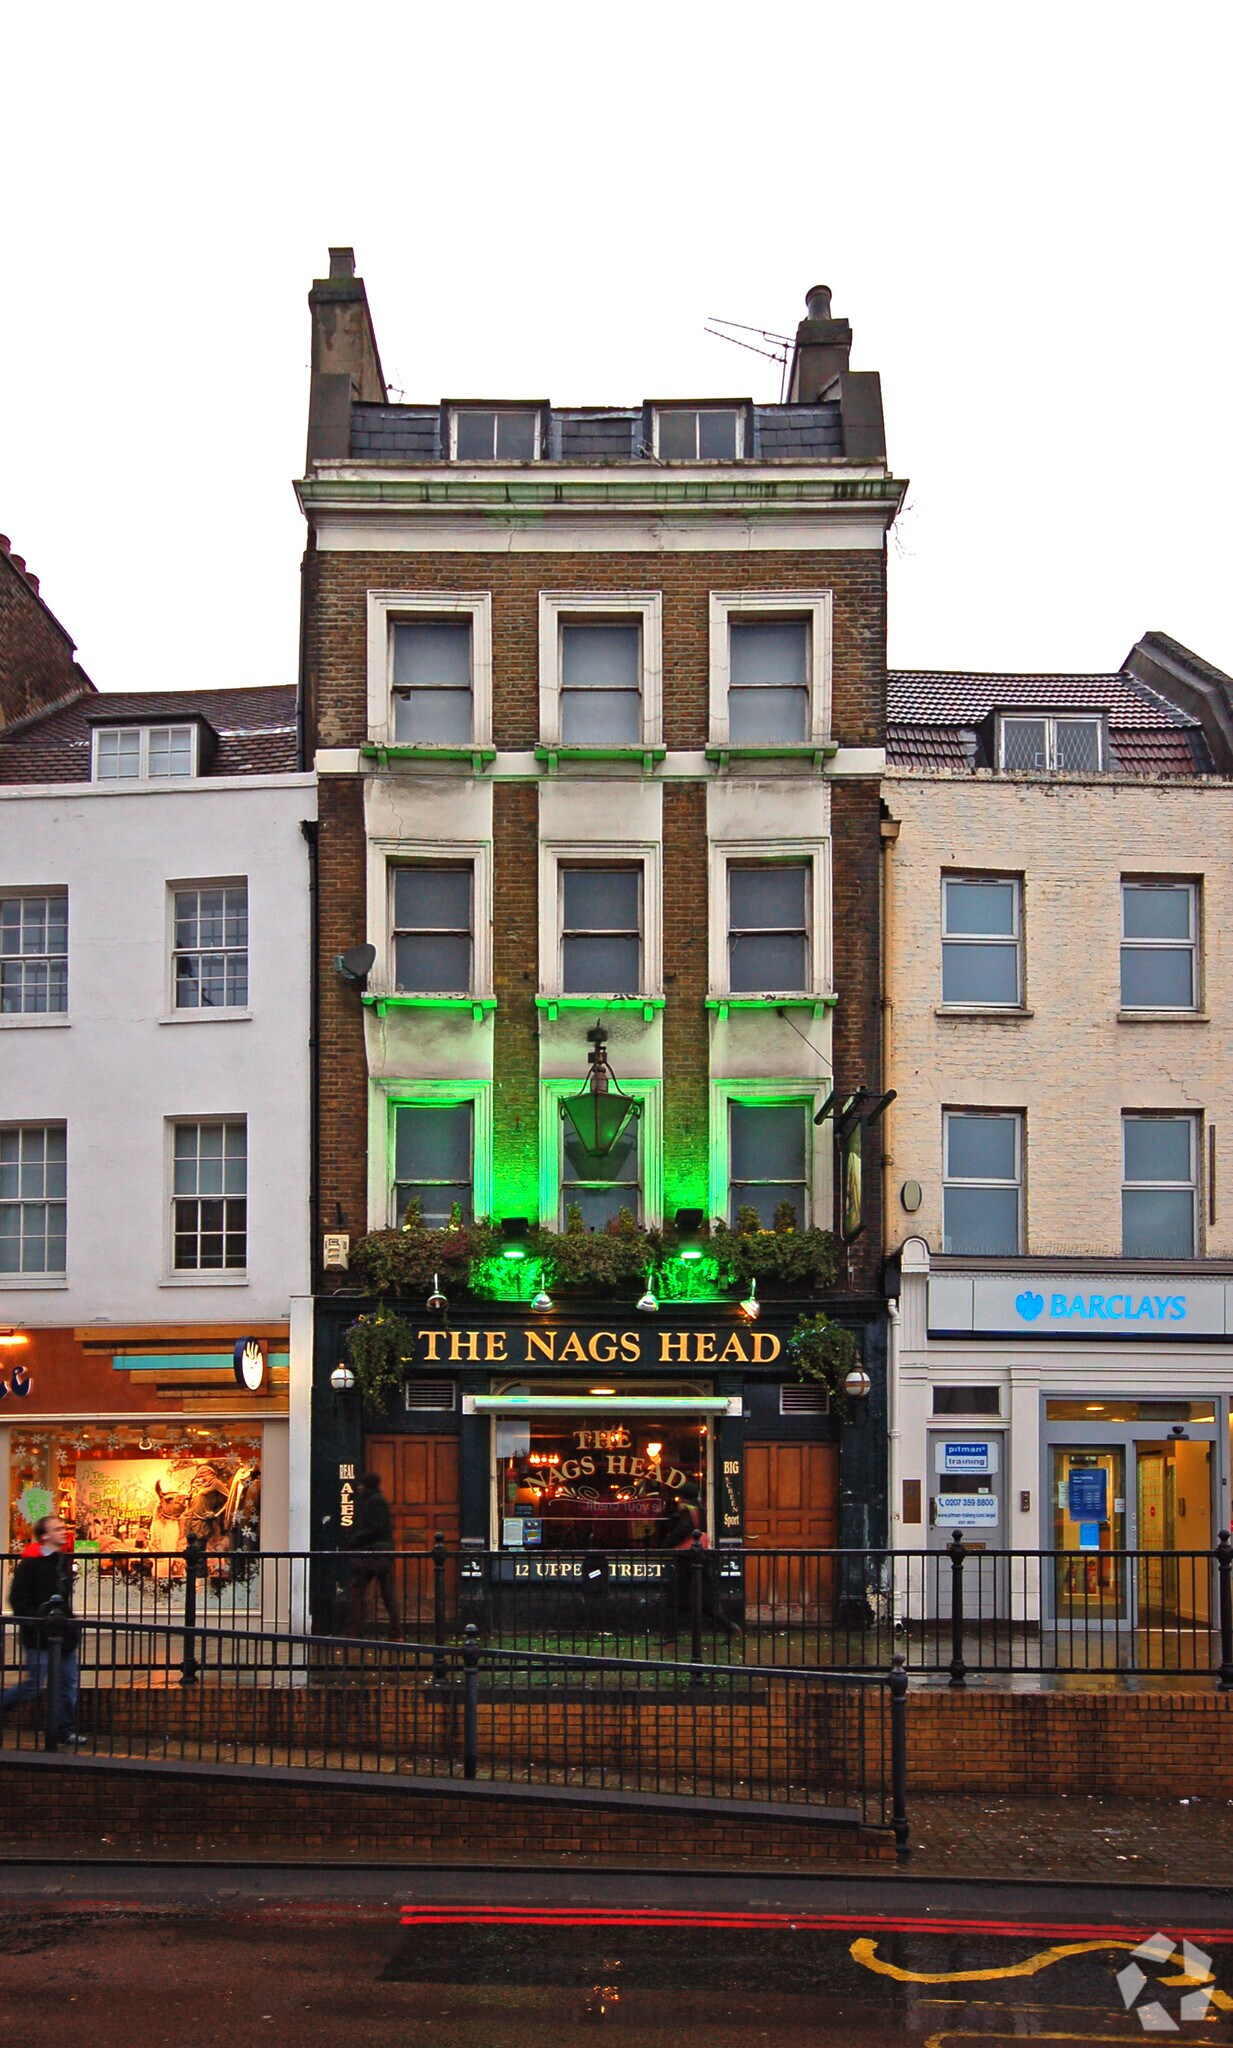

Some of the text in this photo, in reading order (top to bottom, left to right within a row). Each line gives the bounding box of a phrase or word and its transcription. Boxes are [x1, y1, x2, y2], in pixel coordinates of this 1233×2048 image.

[1051, 1294, 1187, 1321] BARCLAYS
[418, 1331, 781, 1363] THE NAGS HEAD
[573, 1429, 632, 1450] THE
[723, 1461, 740, 1474] BIG
[948, 1458, 985, 1466] training
[339, 1464, 355, 1480] REAL
[523, 1455, 687, 1494] NAGS HEAD
[724, 1477, 739, 1513] SCREEN
[945, 1499, 961, 1507] 0207
[963, 1499, 976, 1507] 359
[340, 1482, 354, 1527] ALES
[724, 1513, 740, 1528] Sport
[515, 1564, 529, 1576] 12
[536, 1563, 583, 1576] UPPE
[608, 1563, 665, 1577] TREET
